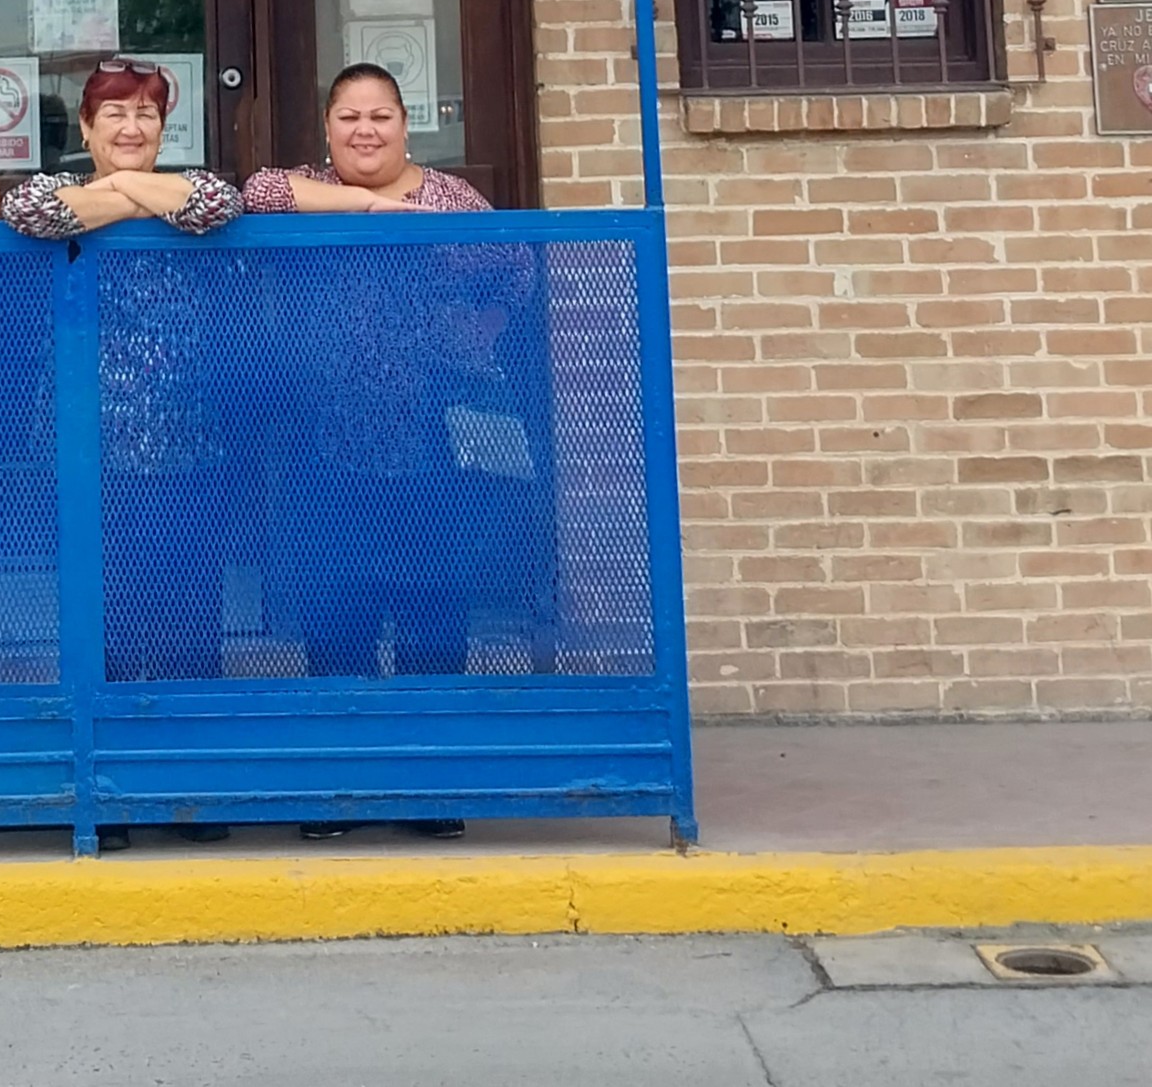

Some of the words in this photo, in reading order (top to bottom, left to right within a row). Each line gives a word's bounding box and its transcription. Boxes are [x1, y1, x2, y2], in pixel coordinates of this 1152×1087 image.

[755, 13, 779, 26] 2015
[848, 10, 873, 21] 2016
[899, 9, 925, 22] 2018
[1101, 26, 1117, 37] YA
[1123, 25, 1142, 37] NO
[1100, 40, 1135, 52] CRUZ
[1107, 53, 1125, 65] EN
